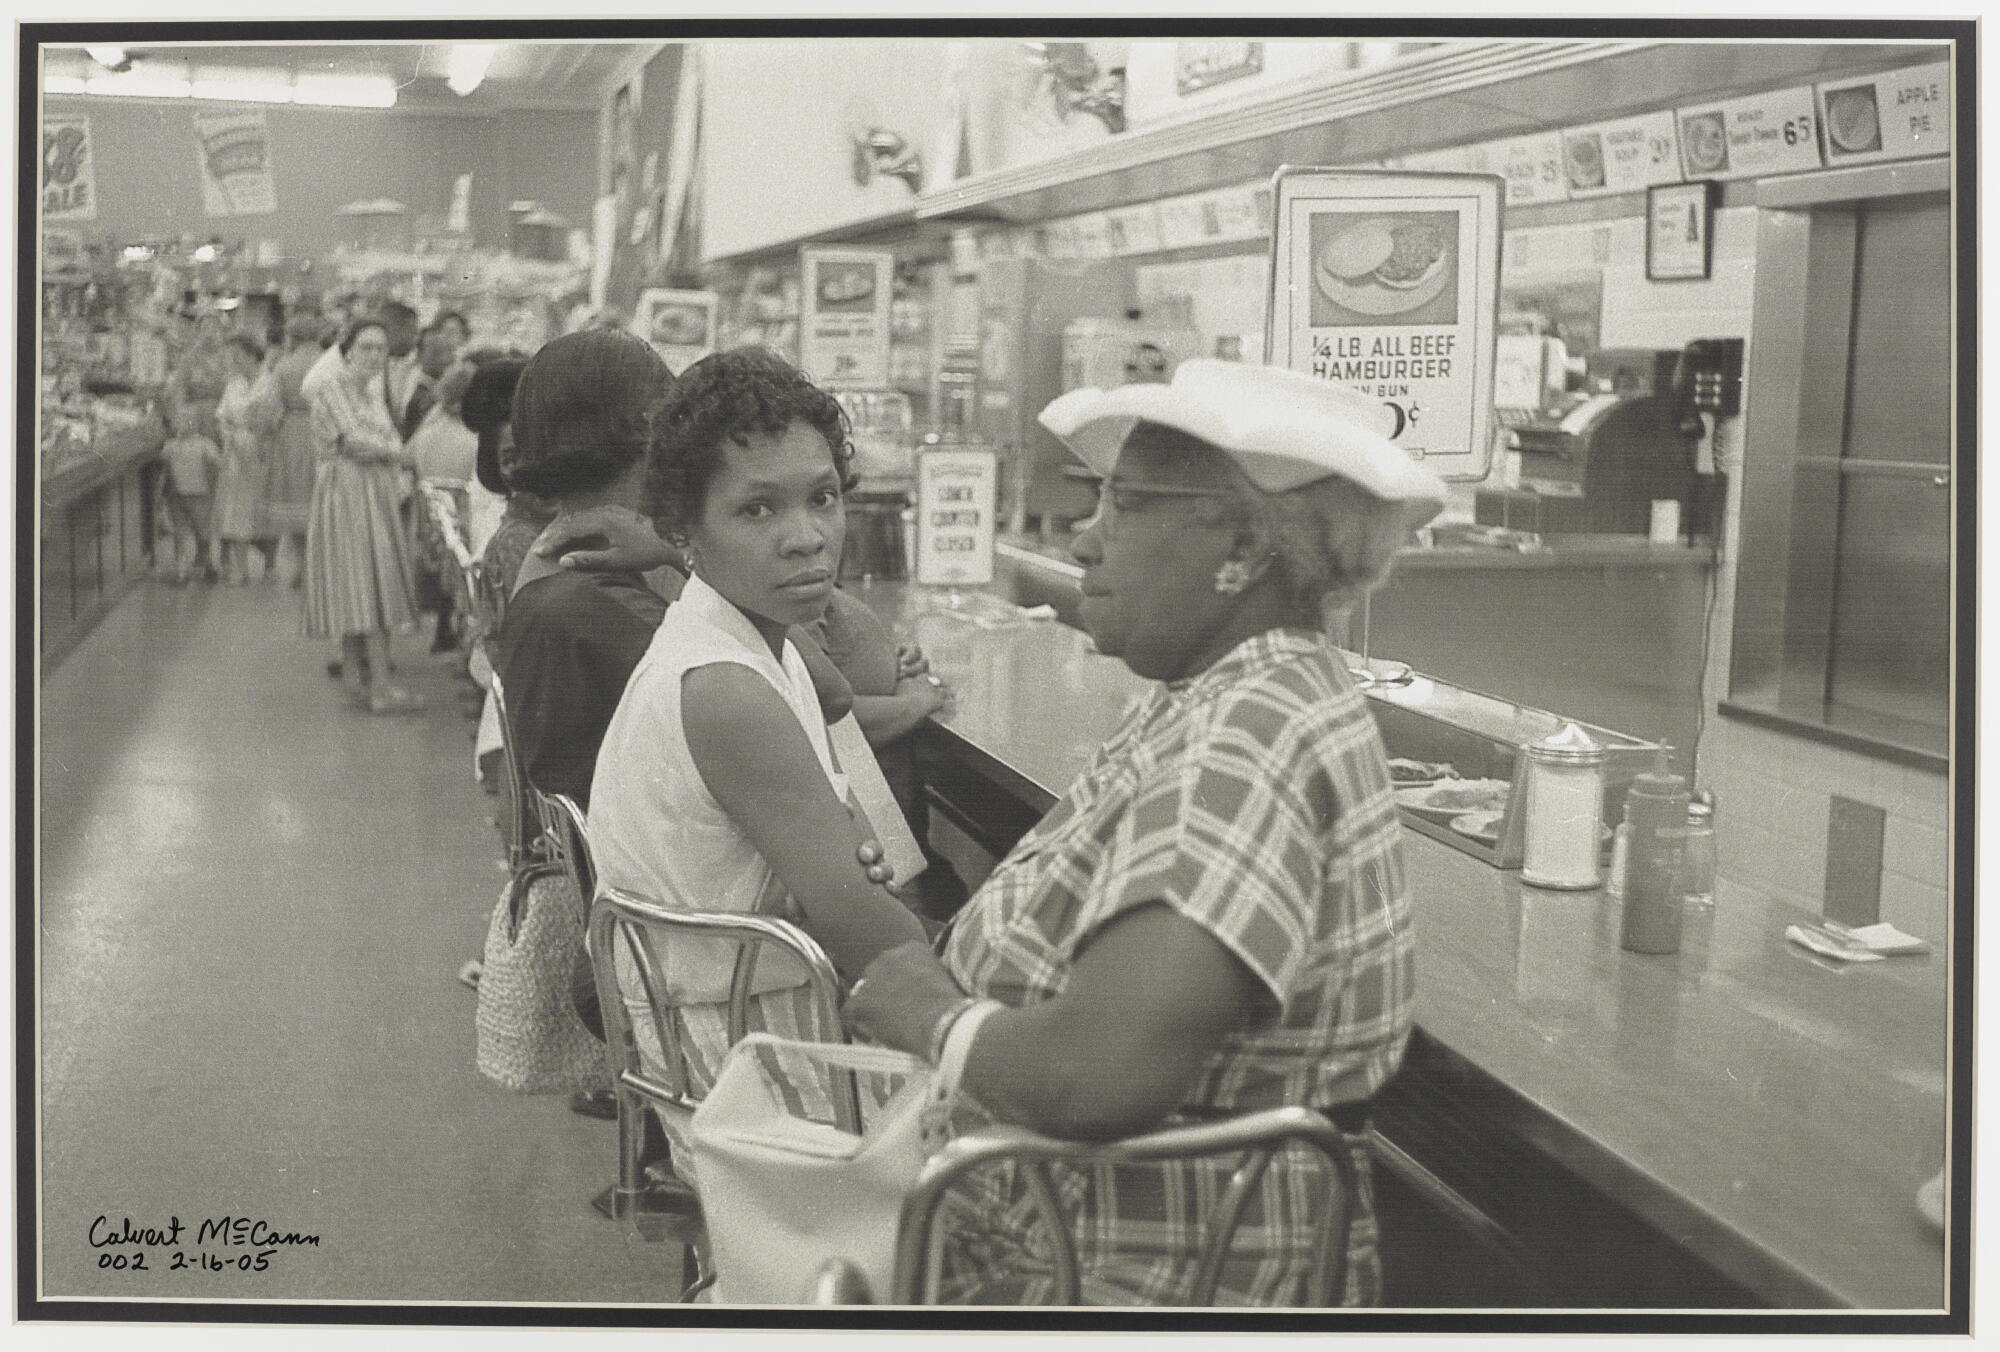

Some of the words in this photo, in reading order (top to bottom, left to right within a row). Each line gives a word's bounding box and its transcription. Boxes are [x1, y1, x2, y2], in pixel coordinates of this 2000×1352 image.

[1897, 83, 1940, 105] APPLE
[1371, 336, 1405, 357] ALL
[1410, 335, 1456, 356] BEEF
[1312, 358, 1452, 381] HAMBURGER
[1352, 384, 1371, 396] N
[1377, 384, 1409, 397] BUN
[89, 1215, 186, 1248] Calvert
[98, 1252, 149, 1271] 002
[170, 1249, 278, 1271] 2-16-05
